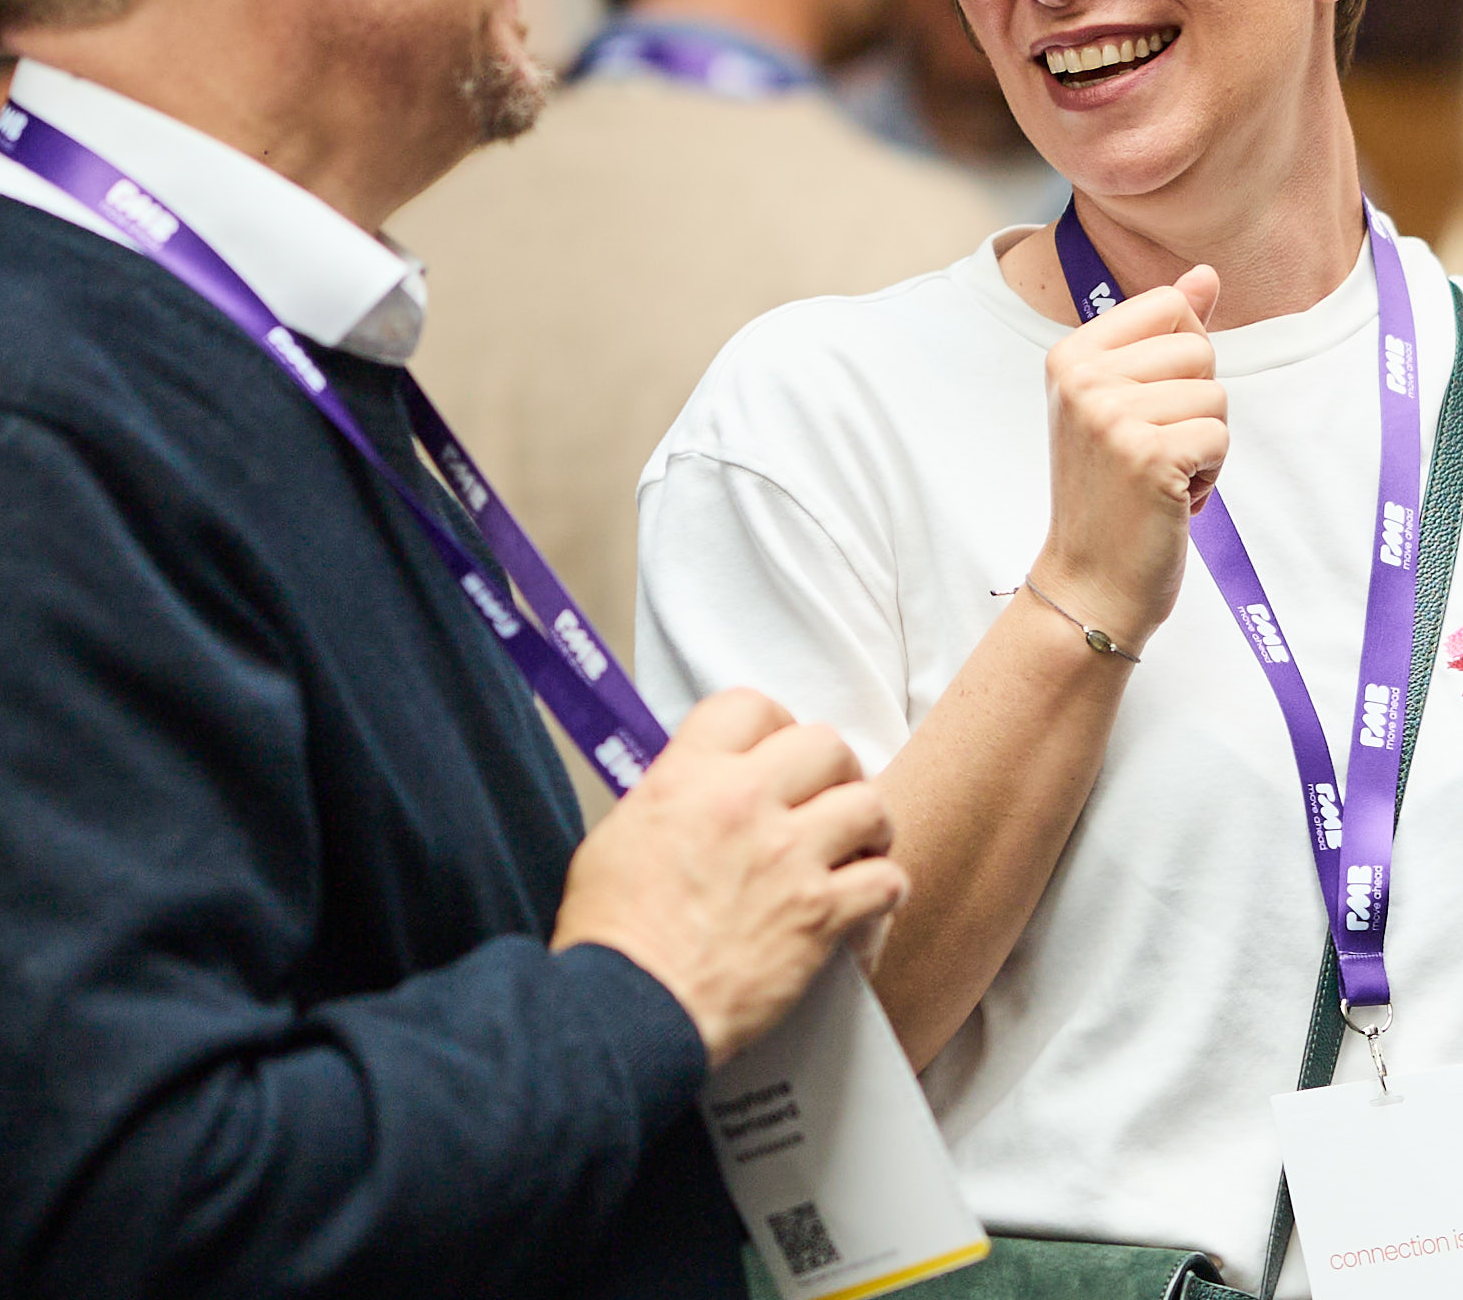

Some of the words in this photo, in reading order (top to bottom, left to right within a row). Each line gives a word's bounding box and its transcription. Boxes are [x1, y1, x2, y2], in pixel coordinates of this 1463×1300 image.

[1404, 508, 1414, 540] ahead
[1403, 542, 1412, 570] move
[1237, 606, 1256, 632] move
[1251, 633, 1273, 664] ahead
[1388, 687, 1400, 719] ahead
[1386, 721, 1396, 750] move
[1307, 783, 1319, 814] move
[1313, 815, 1328, 851] ahead
[1372, 865, 1383, 900] ahead
[1372, 902, 1381, 931] move
[1330, 1235, 1450, 1270] connection
